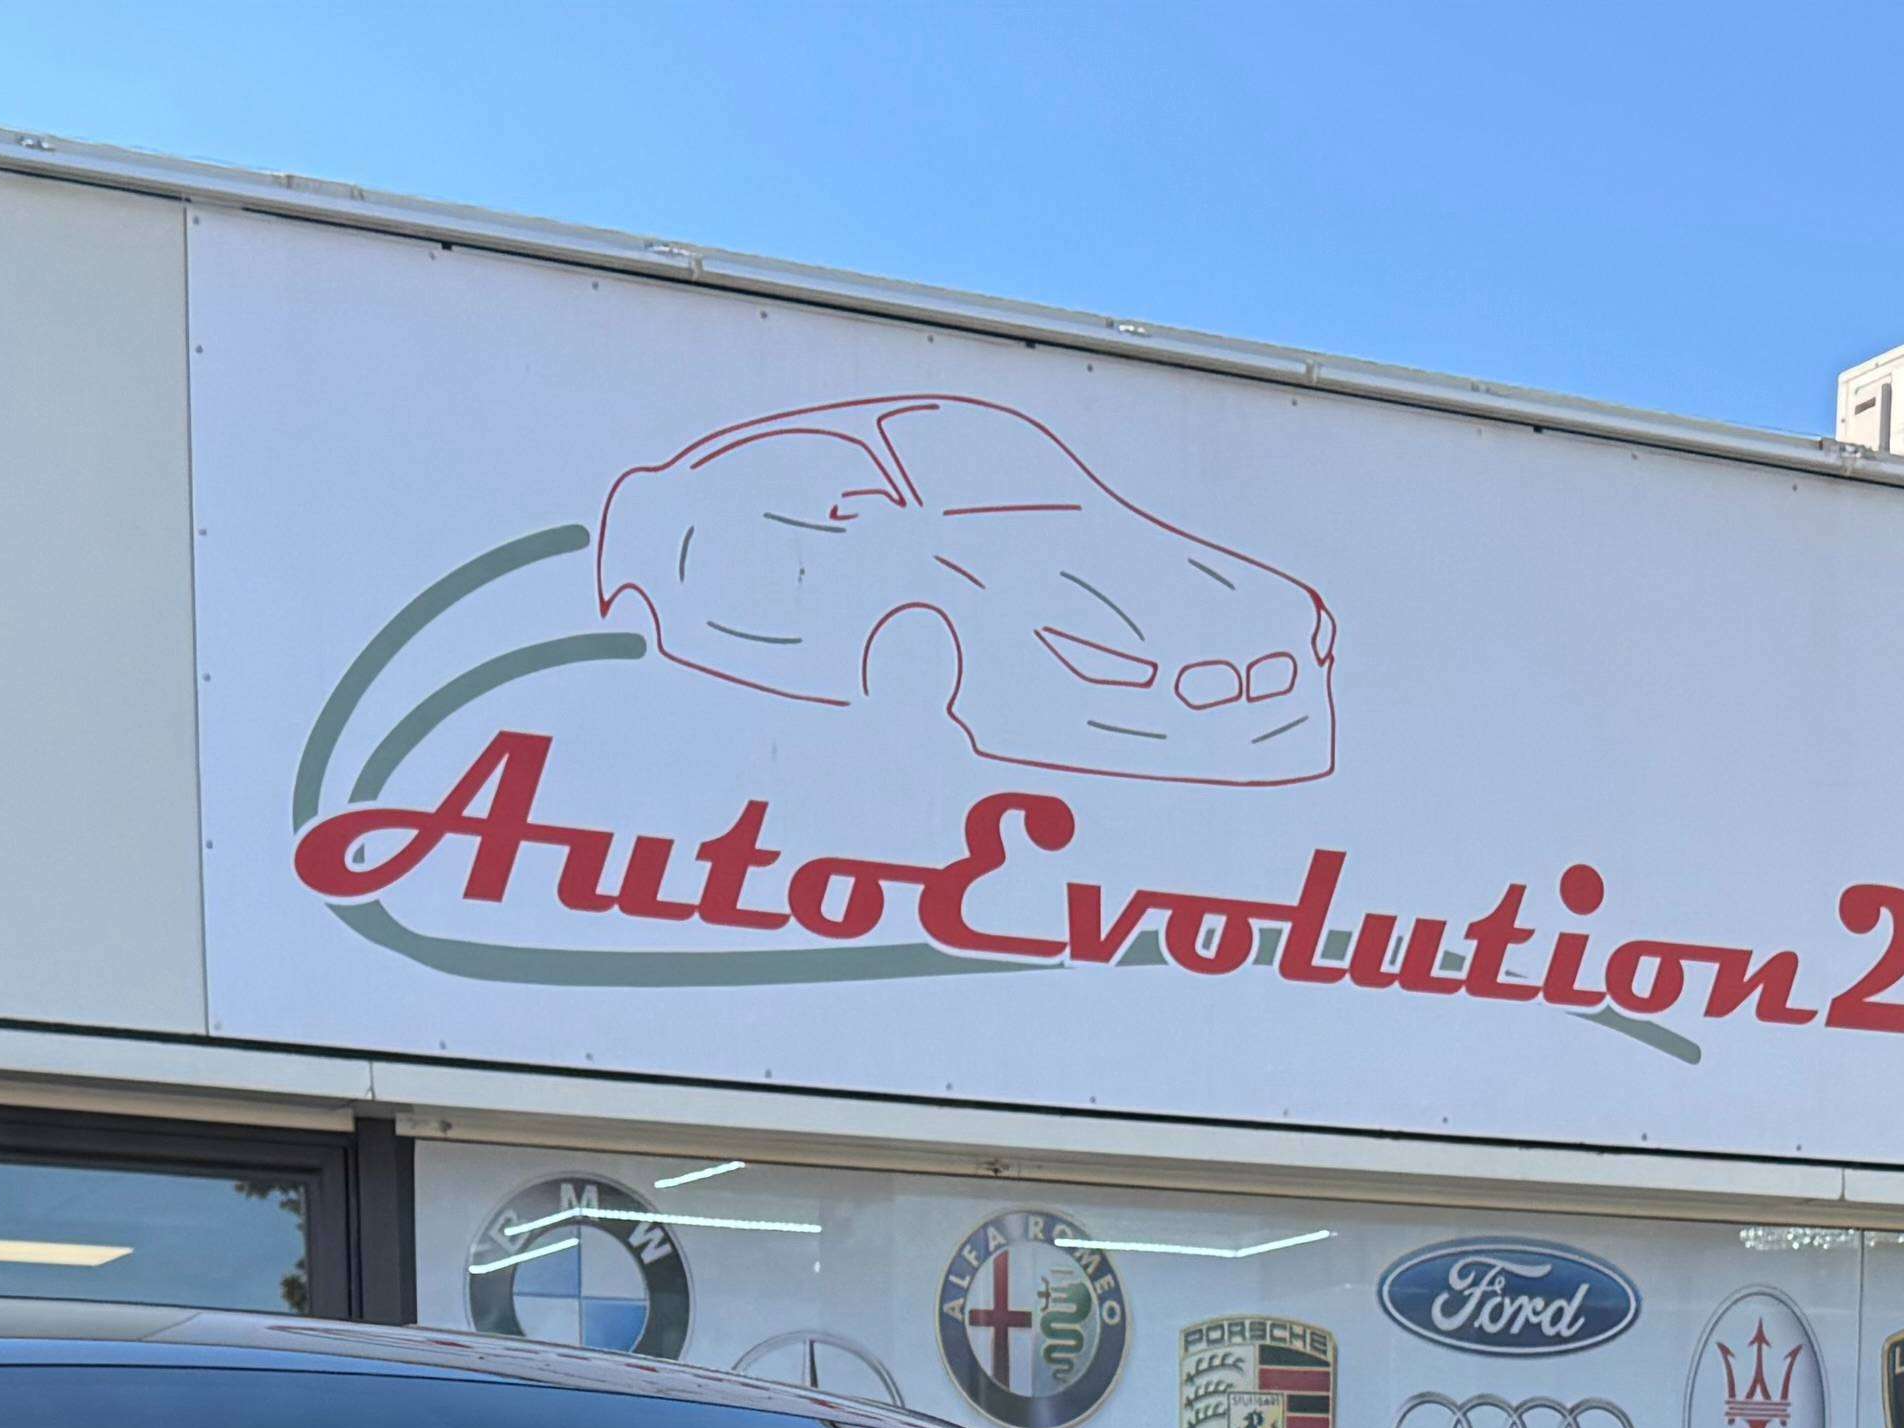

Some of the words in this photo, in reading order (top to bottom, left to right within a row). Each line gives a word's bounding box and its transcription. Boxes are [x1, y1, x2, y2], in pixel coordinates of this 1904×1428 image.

[943, 1225, 1007, 1321] ALFA
[1026, 1215, 1121, 1326] ROMEO
[1430, 1256, 1593, 1338] Ford
[1183, 1320, 1329, 1356] PORSCHE
